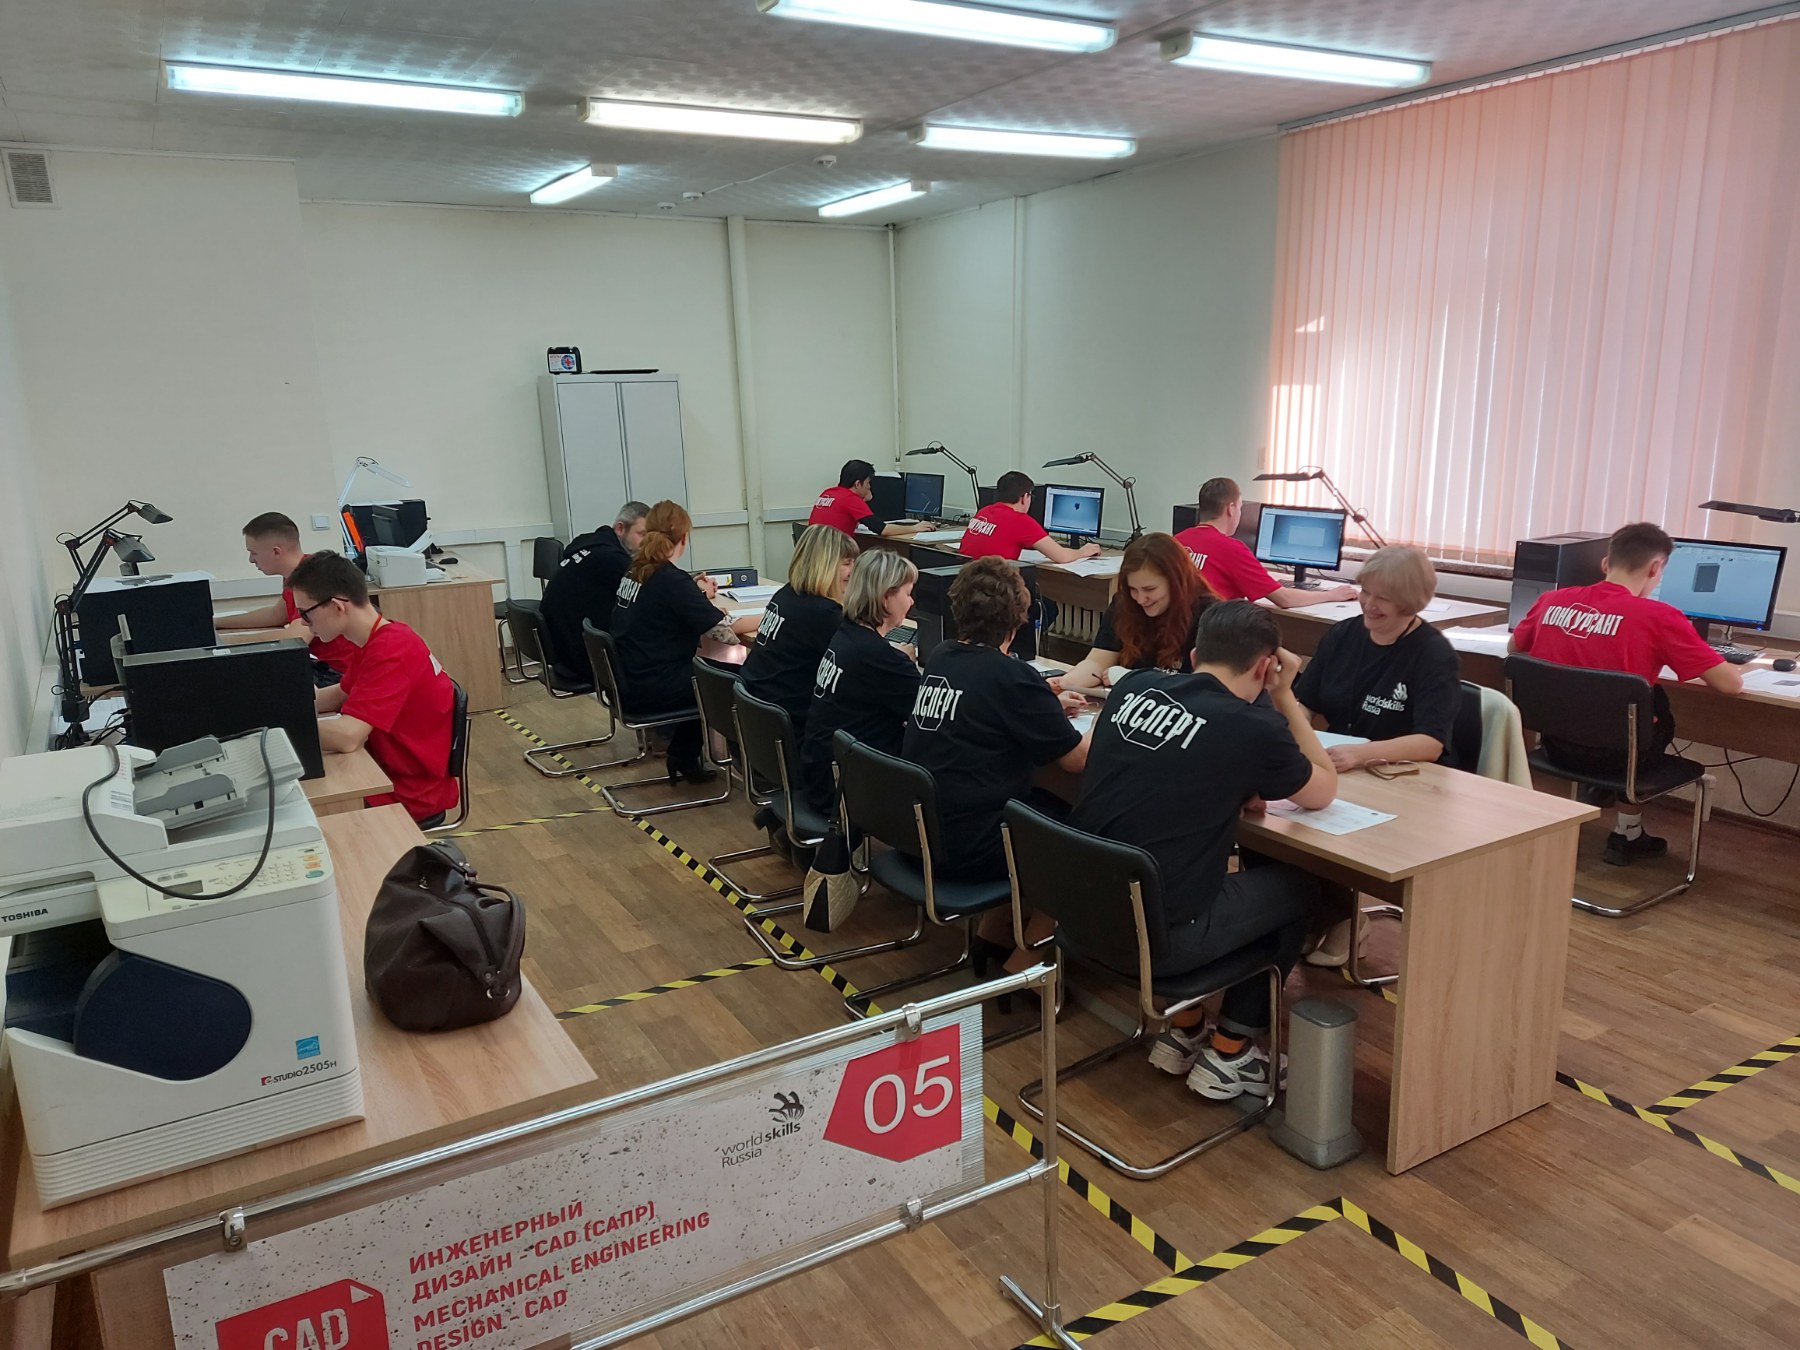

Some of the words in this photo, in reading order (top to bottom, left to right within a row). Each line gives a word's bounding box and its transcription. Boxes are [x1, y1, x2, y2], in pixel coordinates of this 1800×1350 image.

[1541, 605, 1624, 636] КОНКУРСАНТ
[1110, 692, 1208, 750] ЭКСПЕРТ
[1, 908, 48, 923] TOSHIBA
[863, 1055, 954, 1135] 05
[721, 1148, 762, 1169] Russia
[409, 1199, 583, 1275] ИНЖЕНЕРНЫЙ
[411, 1252, 513, 1304] ДИЗАЙН
[534, 1230, 577, 1258] CAD
[413, 1265, 565, 1332] MECHANICAL
[570, 1211, 710, 1275] ENGINEERING
[263, 1308, 349, 1350] CAD
[416, 1313, 504, 1350] DESIGN
[524, 1289, 567, 1319] CAD
